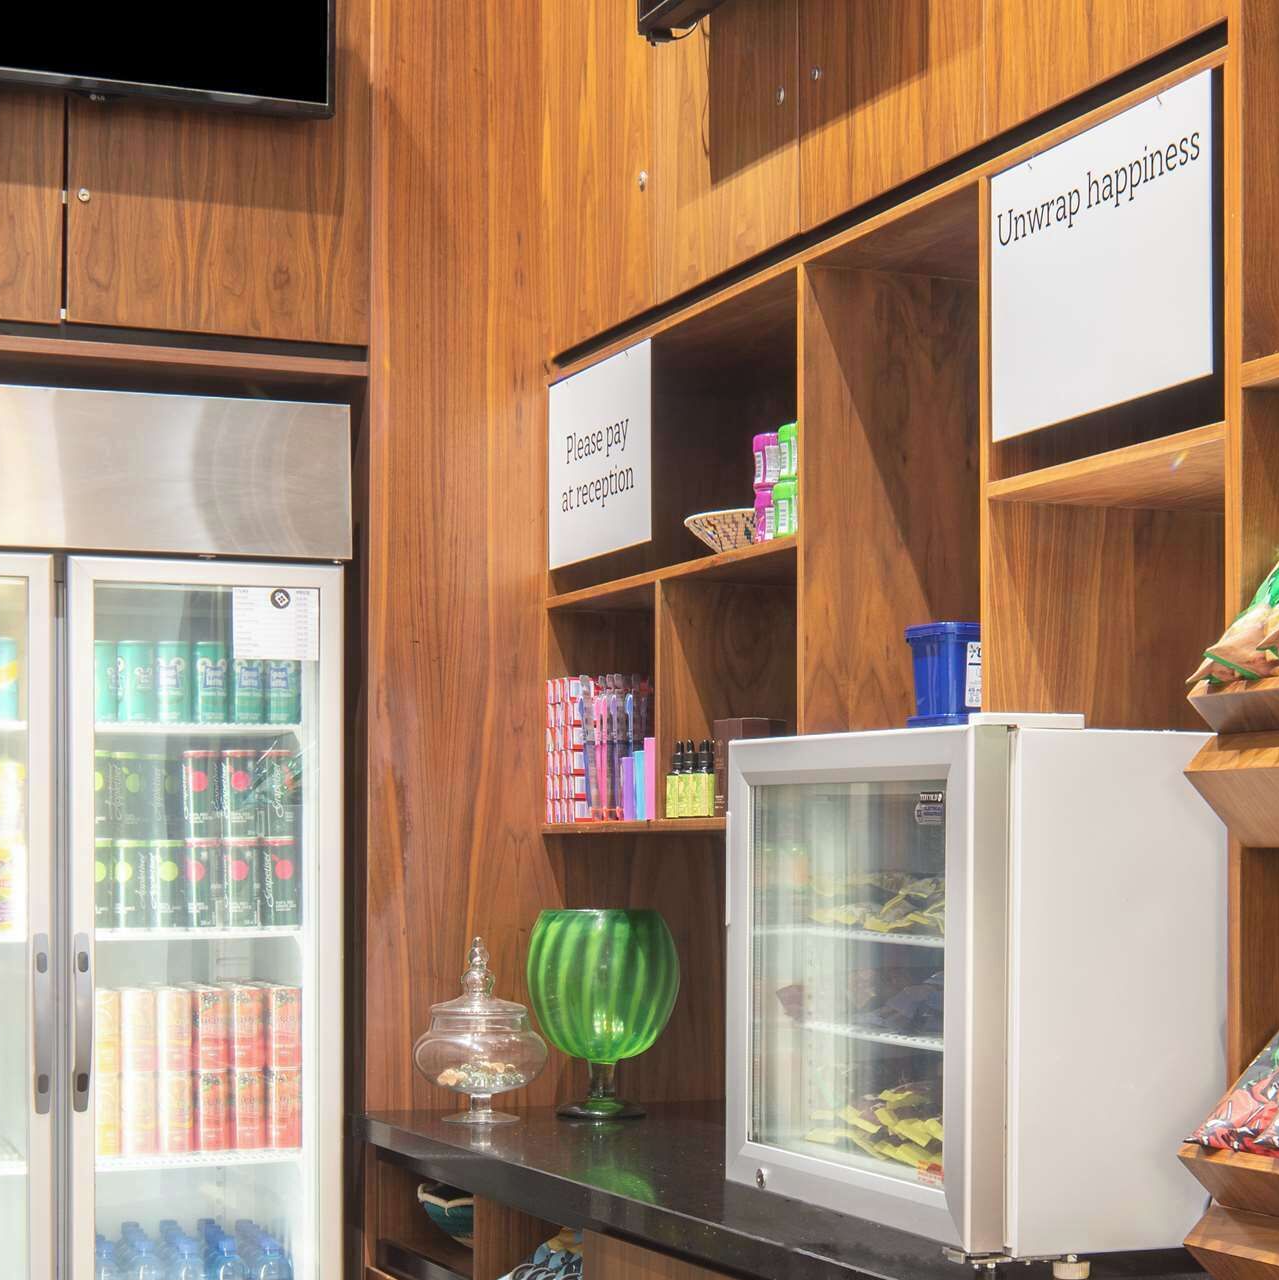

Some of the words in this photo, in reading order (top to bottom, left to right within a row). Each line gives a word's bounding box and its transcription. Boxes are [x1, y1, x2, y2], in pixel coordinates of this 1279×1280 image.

[997, 188, 1081, 246] Unwrap
[1086, 131, 1200, 207] happiness
[565, 430, 603, 465] Please
[605, 417, 630, 458] pay
[561, 486, 574, 513] at
[575, 464, 634, 508] reception
